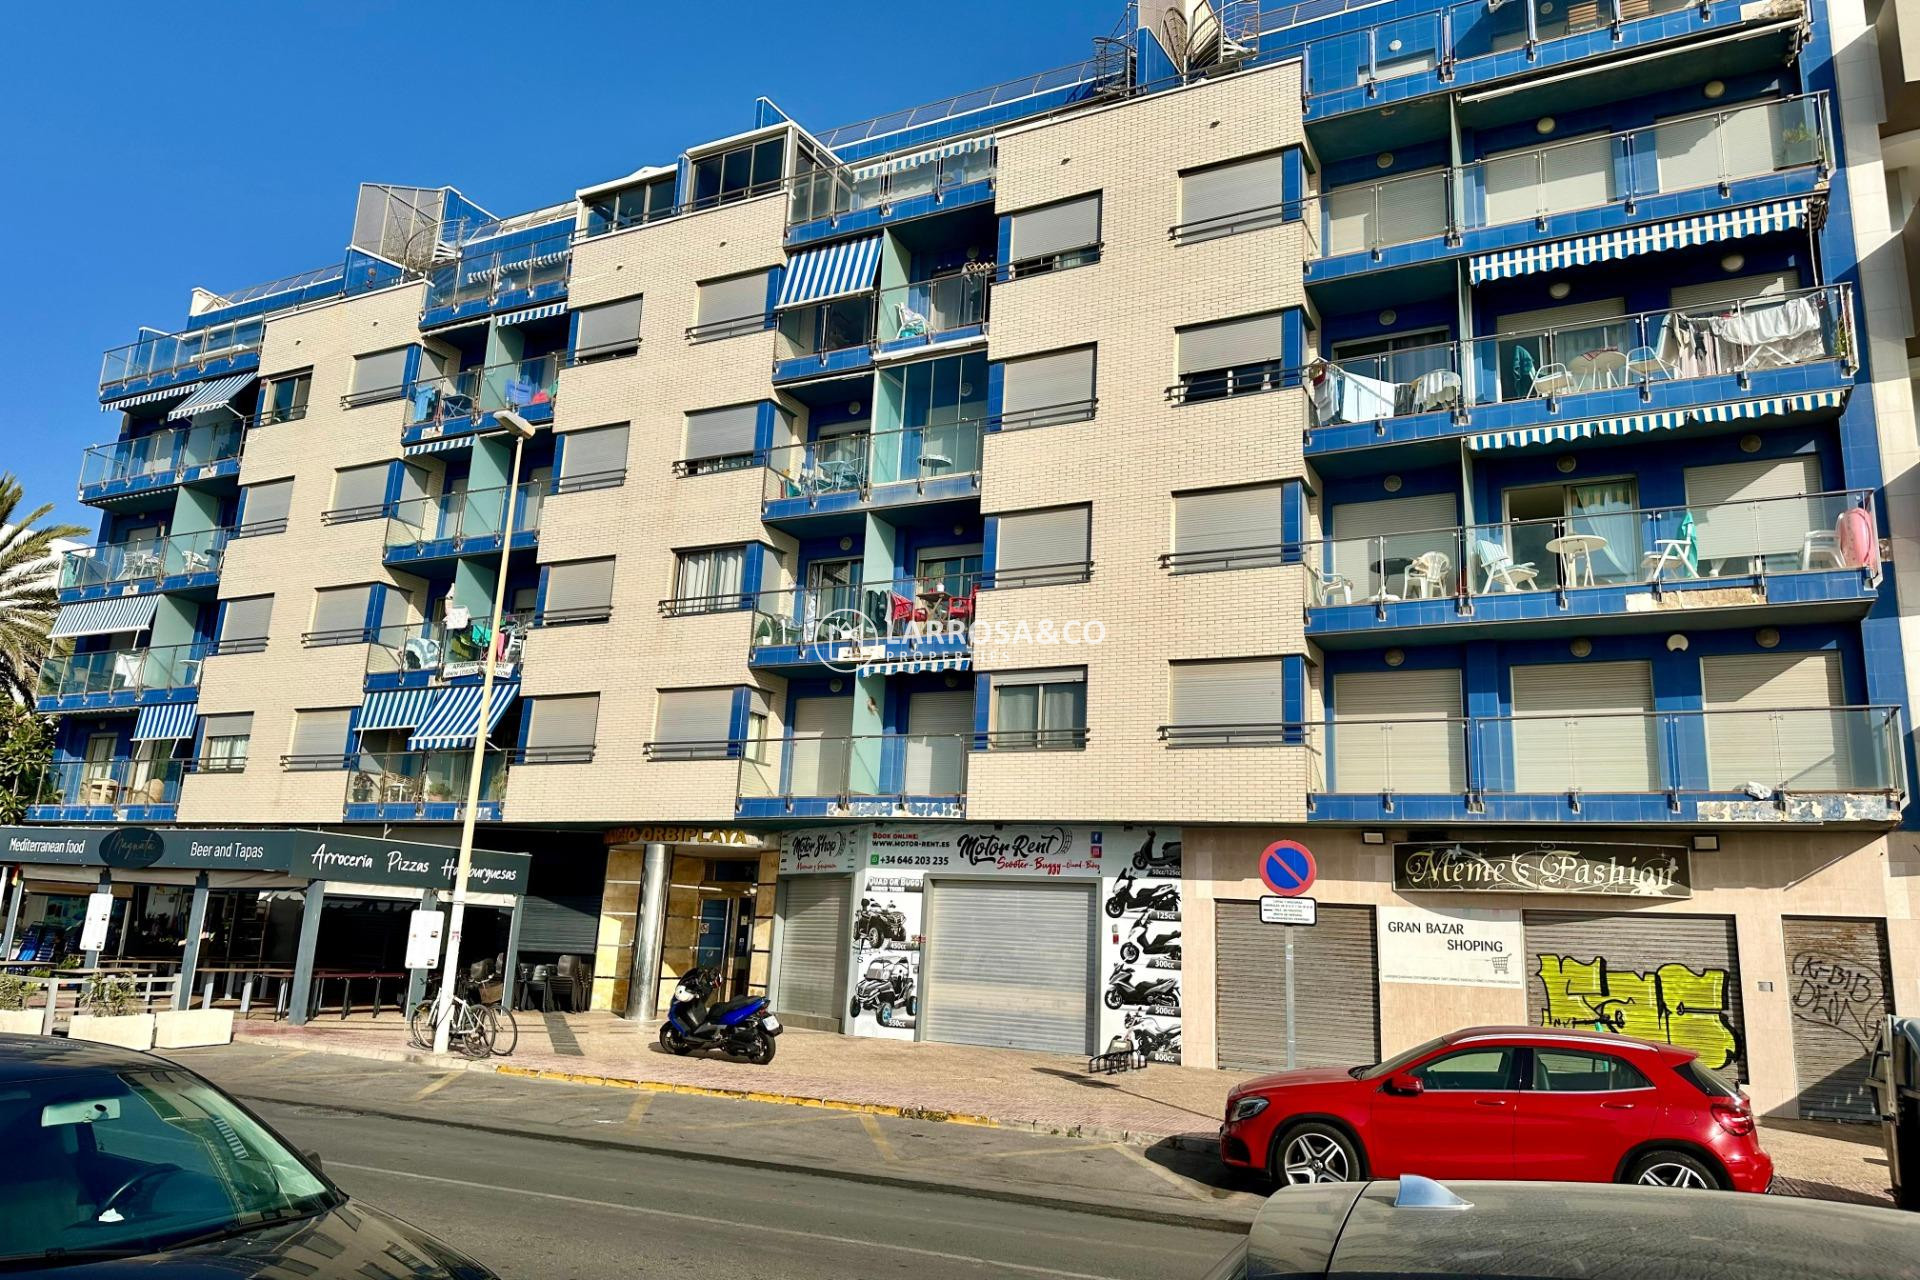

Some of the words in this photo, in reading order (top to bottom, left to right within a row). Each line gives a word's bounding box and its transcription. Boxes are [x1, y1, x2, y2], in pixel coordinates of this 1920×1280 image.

[639, 827, 747, 845] ORBIPLAYA
[9, 838, 65, 853] Mediterranean
[65, 840, 86, 854] food
[872, 840, 950, 848] WWW.MOTOR-RENT.ES
[1011, 834, 1060, 859] Rent
[190, 842, 214, 857] Beer
[214, 842, 233, 858] and
[235, 843, 264, 861] Tapas
[387, 850, 430, 872] Pizzas
[441, 858, 517, 884] Haburguesas
[880, 855, 895, 864] +34
[897, 855, 913, 865] 646
[914, 856, 931, 865] 203
[932, 856, 949, 865] 235
[996, 856, 1029, 870] Scooter
[1034, 856, 1062, 875] Buggy
[1157, 911, 1176, 920] 125cc
[1388, 921, 1421, 934] GRAN
[1426, 922, 1464, 935] BAZAR
[1447, 939, 1503, 952] SHOPING
[1155, 960, 1175, 969] 300cc
[1155, 1005, 1175, 1015] 500cc
